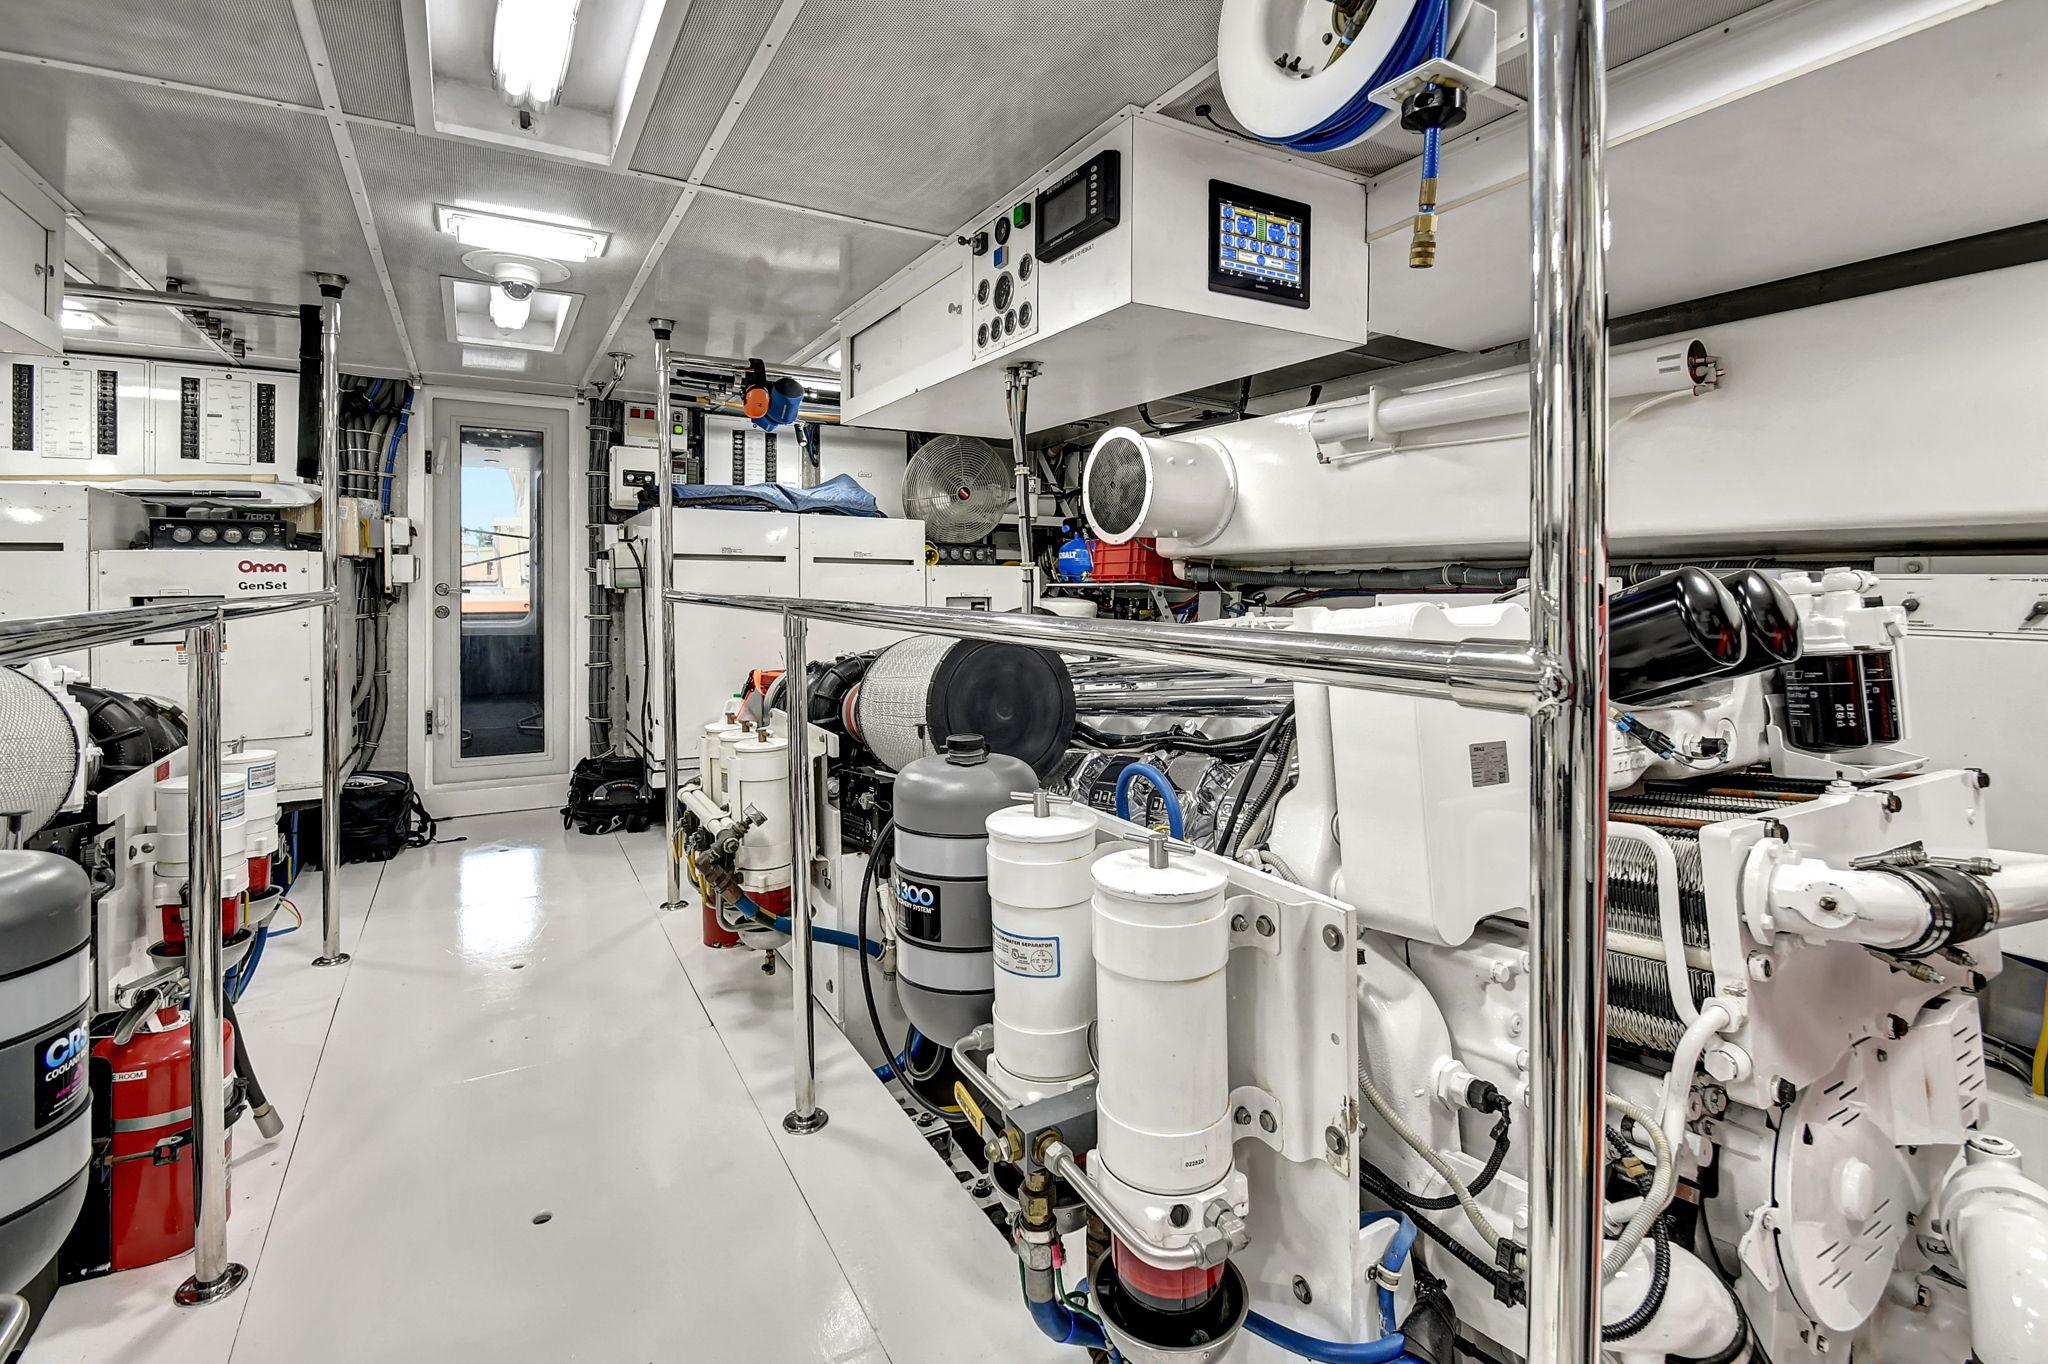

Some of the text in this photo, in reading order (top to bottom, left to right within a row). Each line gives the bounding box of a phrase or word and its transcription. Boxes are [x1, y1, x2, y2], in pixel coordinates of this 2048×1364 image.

[1058, 551, 1076, 559] OBALT
[238, 560, 287, 573] Onan
[238, 581, 288, 590] GenSet
[900, 881, 934, 906] 300
[45, 1051, 81, 1082] COOLANT
[118, 1071, 144, 1081] ROOM
